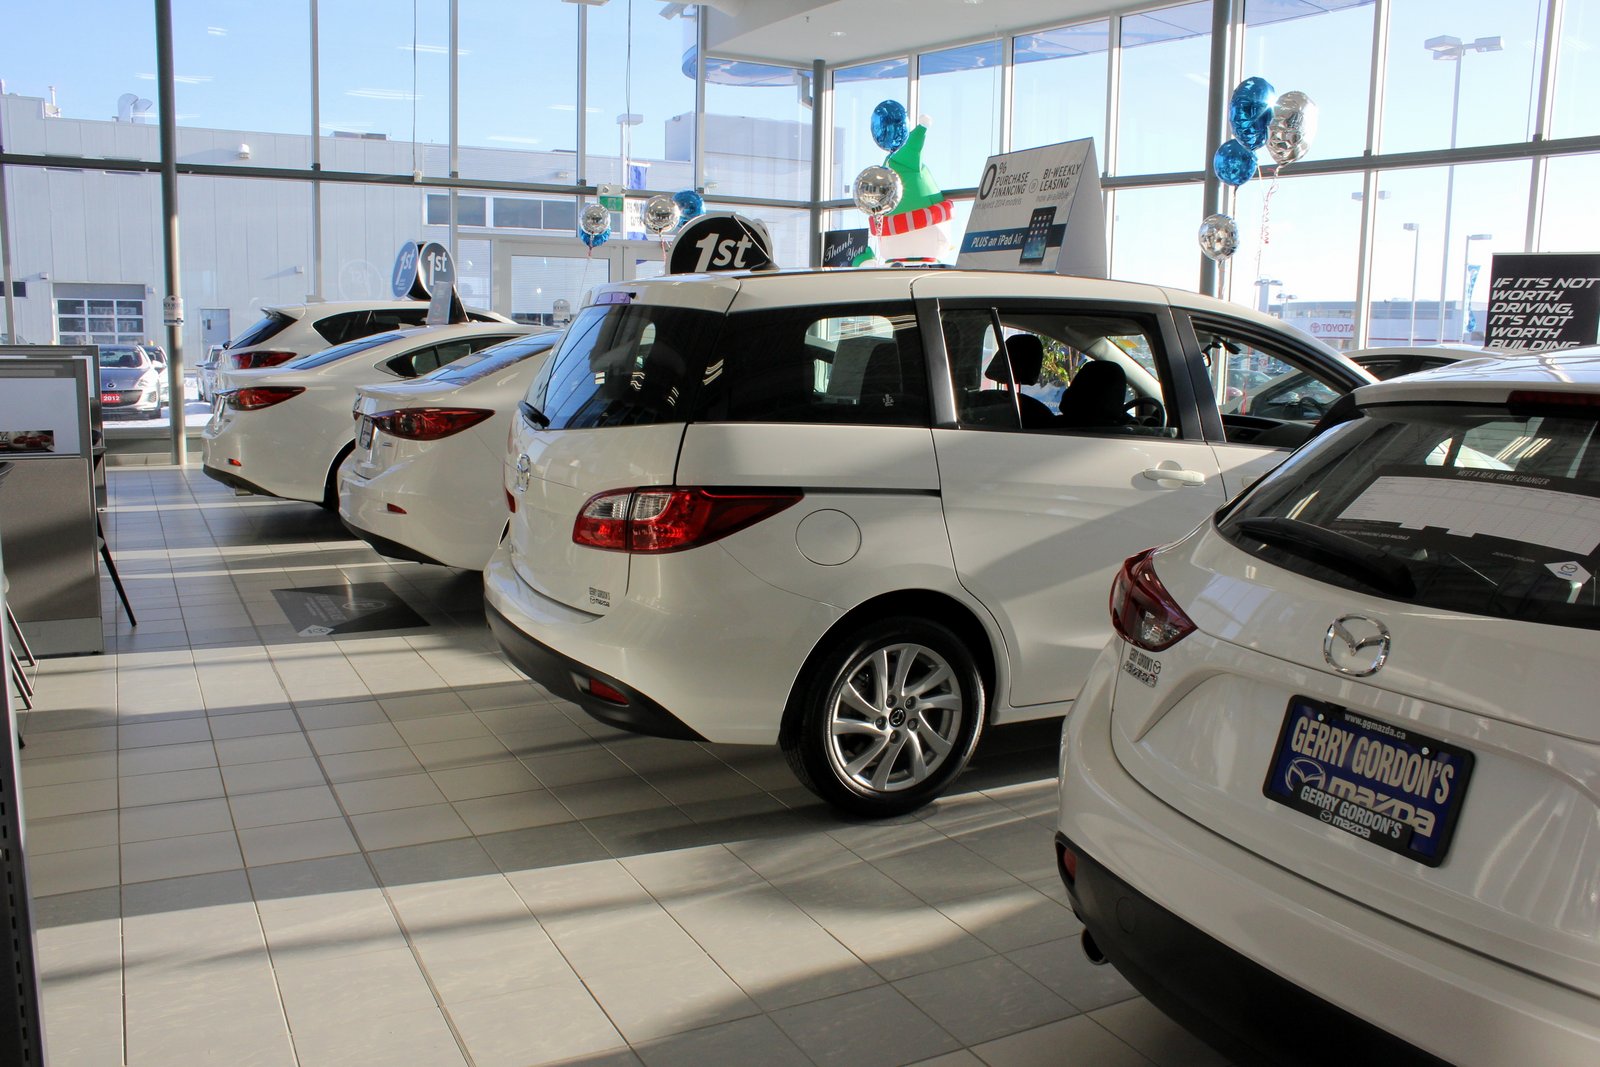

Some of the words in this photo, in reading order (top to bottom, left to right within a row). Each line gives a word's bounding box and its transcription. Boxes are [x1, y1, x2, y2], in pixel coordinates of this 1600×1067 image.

[994, 172, 1030, 186] PURCHASE
[1042, 163, 1082, 180] BI-WEEKLY
[980, 164, 997, 200] 0
[1040, 177, 1070, 192] LEASING
[992, 184, 1026, 198] FINANCING
[825, 232, 855, 262] Thank
[971, 236, 989, 248] PLUS
[988, 237, 997, 247] an
[997, 233, 1014, 246] iPad
[1013, 233, 1024, 245] Air
[696, 233, 752, 272] 1st
[395, 248, 415, 286] 1st
[427, 251, 447, 287] 1st
[1492, 277, 1514, 288] IF
[1514, 277, 1553, 289] IT'S
[1553, 277, 1600, 289] NOT
[1491, 290, 1564, 301] WORTH
[1490, 302, 1574, 316] DRIVING,
[1321, 323, 1355, 333] TOYOTA
[1489, 314, 1527, 325] IT'S
[1527, 315, 1574, 326] NOT
[1490, 327, 1563, 339] WORTH
[1344, 713, 1406, 740] www.ggmazda.ca
[1291, 716, 1354, 768] GERRY
[1352, 736, 1454, 805] GORDON'S
[1301, 785, 1341, 812] GERRY
[1339, 800, 1402, 839] GORDON'S
[1328, 776, 1436, 838] mazda
[1332, 816, 1371, 839] mazda
